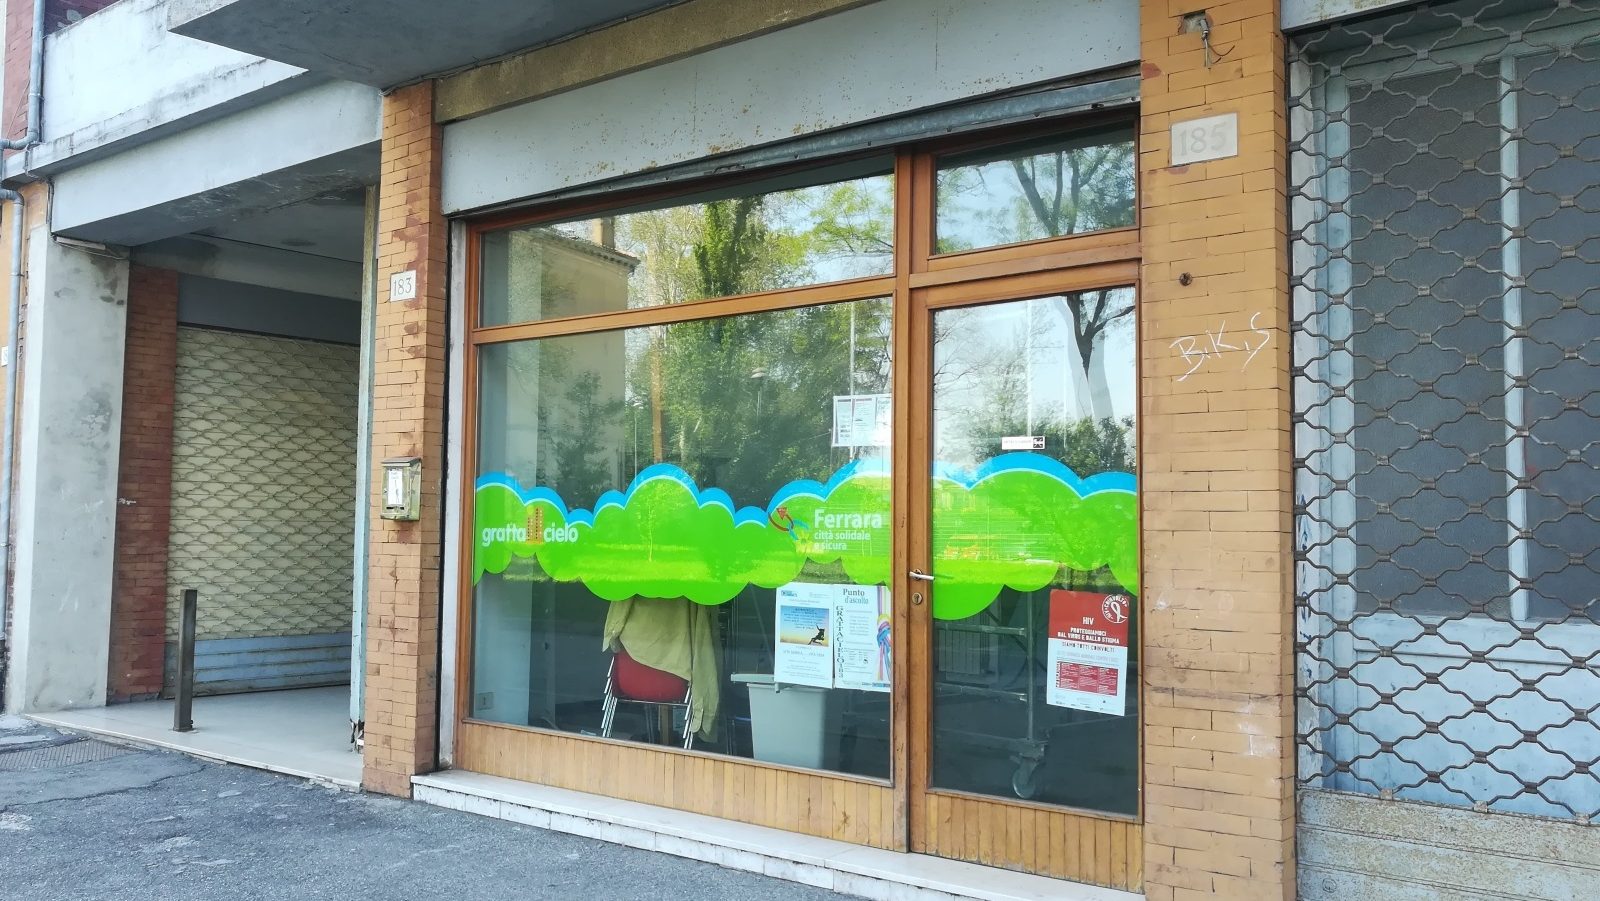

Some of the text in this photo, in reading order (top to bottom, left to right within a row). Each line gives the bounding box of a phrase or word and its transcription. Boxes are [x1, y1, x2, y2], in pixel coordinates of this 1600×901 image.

[1180, 121, 1226, 156] 185
[394, 277, 412, 296] 183
[814, 508, 882, 529] Ferrara
[482, 521, 579, 548] gratta cielo
[814, 529, 871, 541] città solidale
[821, 540, 848, 551] sicura
[843, 588, 865, 597] Punto
[1083, 617, 1095, 626] HIV
[1070, 627, 1107, 637] PROTEGGIAMOCI
